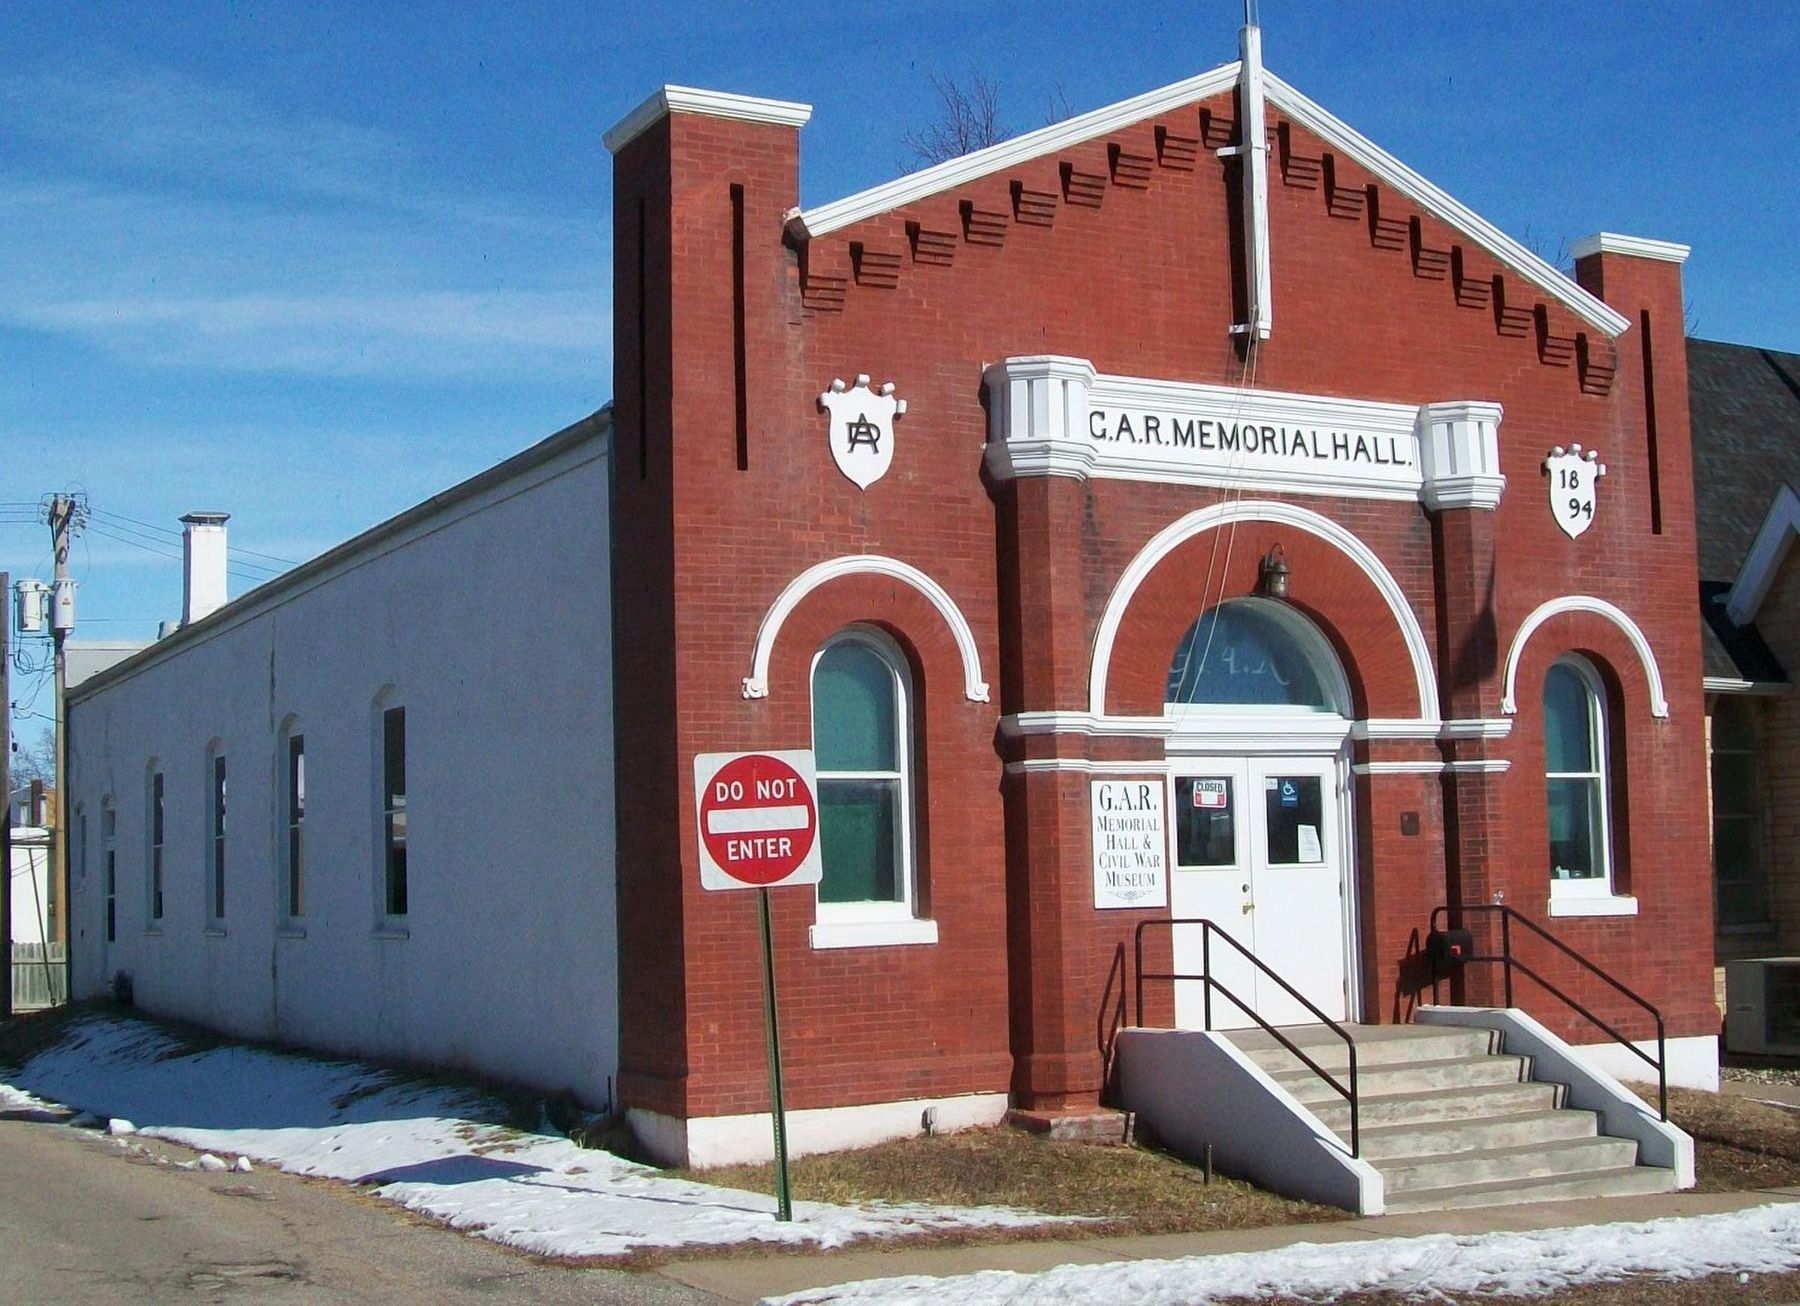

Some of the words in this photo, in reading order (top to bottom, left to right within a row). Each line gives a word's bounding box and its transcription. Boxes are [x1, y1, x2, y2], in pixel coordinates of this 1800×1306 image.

[1171, 417, 1329, 459] MEMORIAL
[1332, 431, 1413, 467] HALL.
[1560, 468, 1580, 490] 18
[1568, 497, 1593, 521] 94
[715, 780, 744, 802] DO
[756, 778, 797, 800] NOT
[1099, 784, 1158, 812] G.A.R.
[1196, 781, 1223, 794] CLOSED
[1097, 815, 1160, 832] MEMORIAL
[727, 837, 792, 861] ENTER
[1106, 833, 1138, 850] HALL
[1142, 833, 1152, 850] &
[1098, 851, 1131, 870] CIVIL
[1134, 851, 1160, 869] WAR
[1105, 870, 1155, 888] MUSEUM
